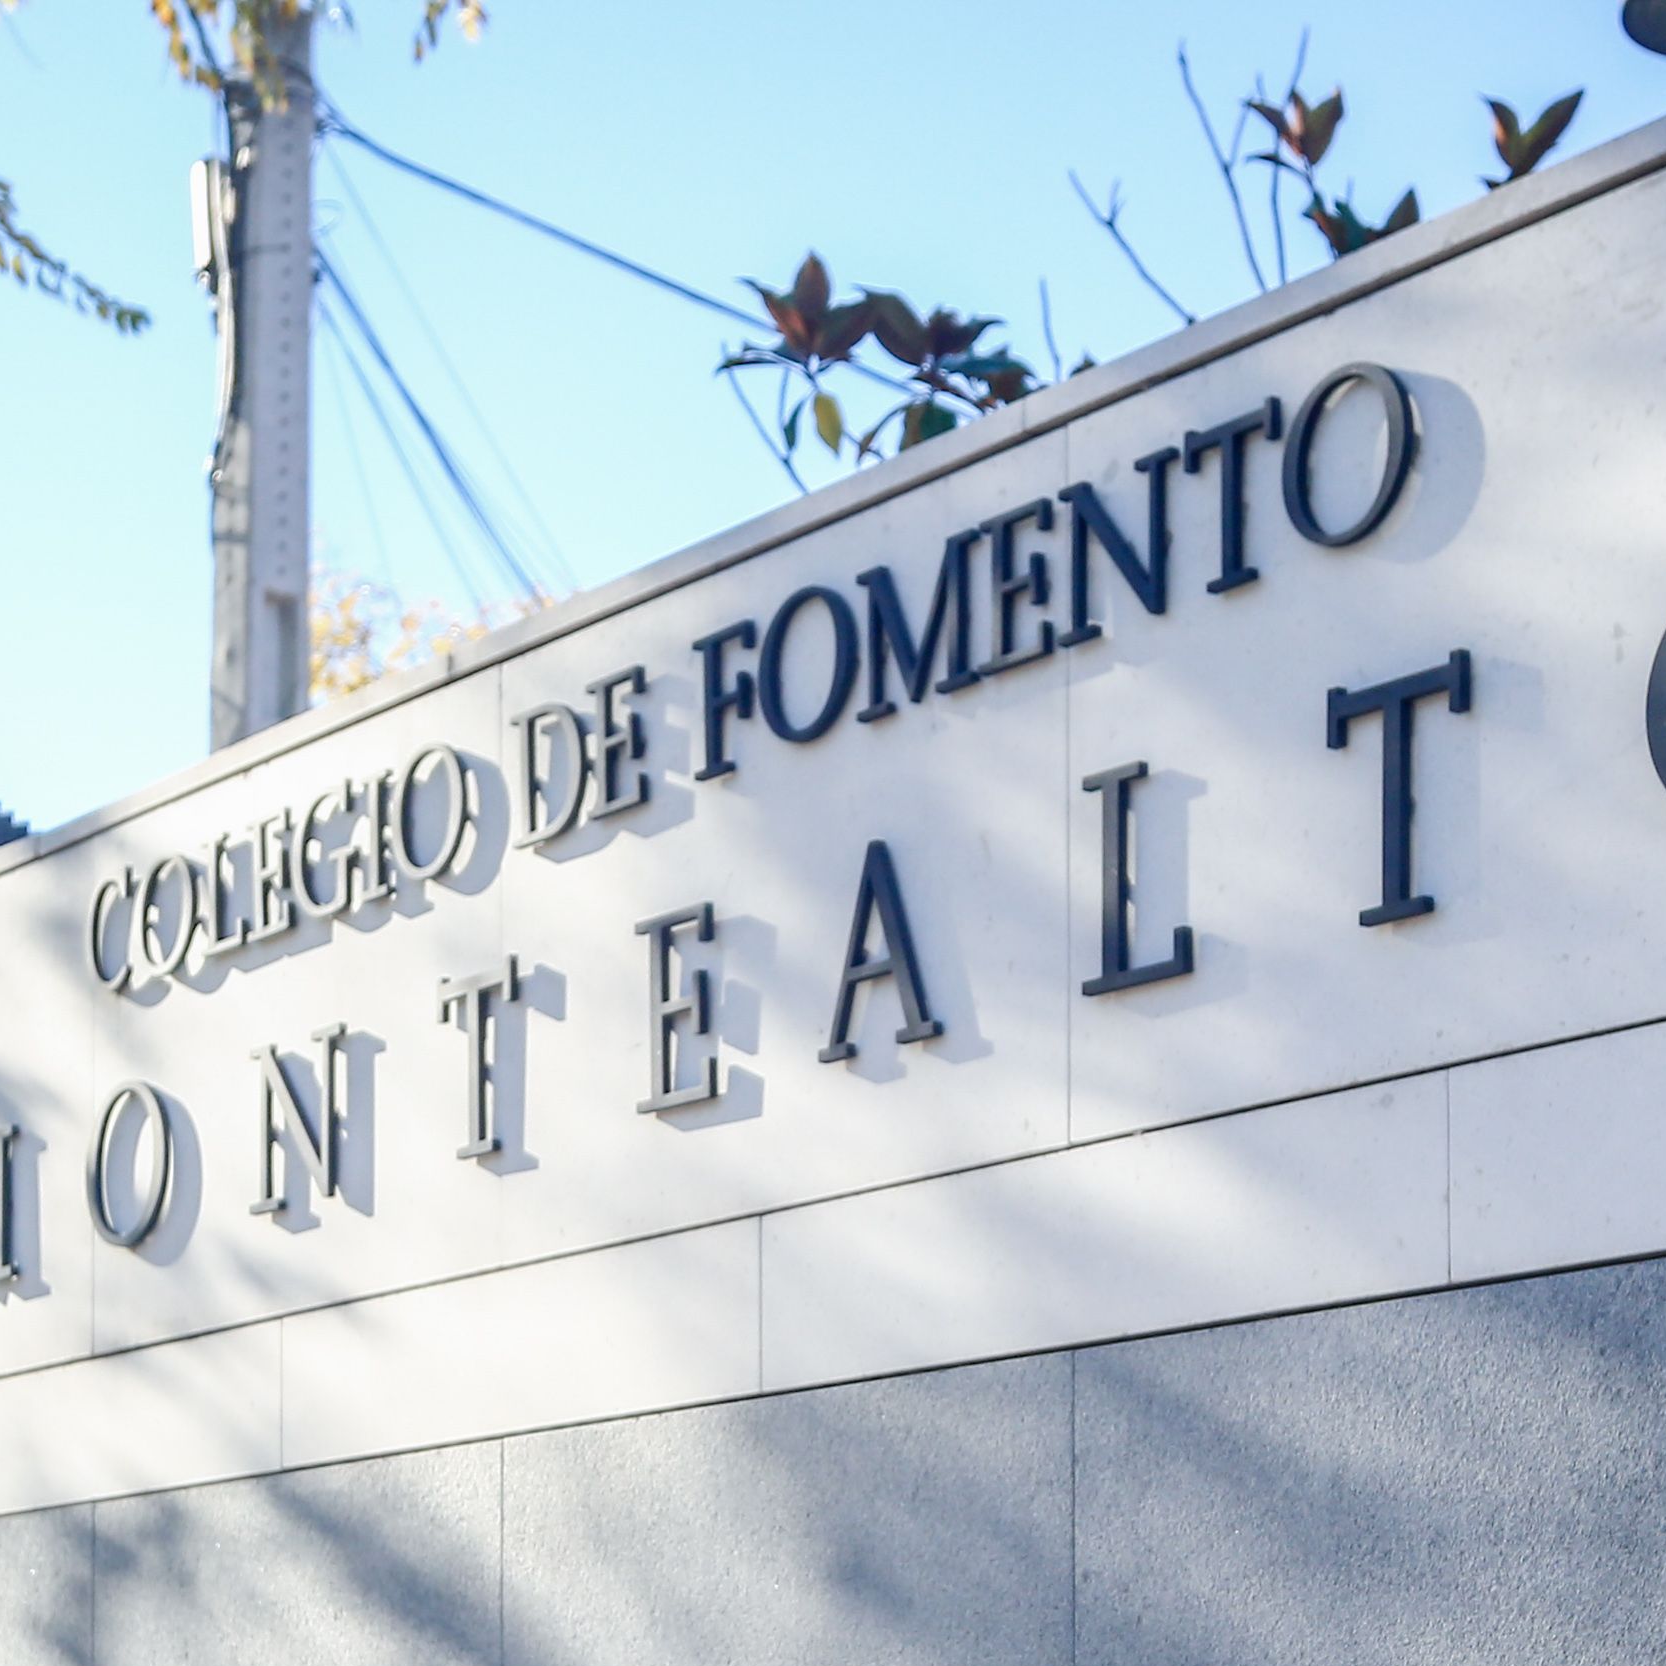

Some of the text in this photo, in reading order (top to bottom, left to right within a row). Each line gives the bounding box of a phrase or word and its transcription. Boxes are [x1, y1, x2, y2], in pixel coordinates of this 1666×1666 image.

[87, 362, 1421, 993] COLEGIO DE FOMENTO
